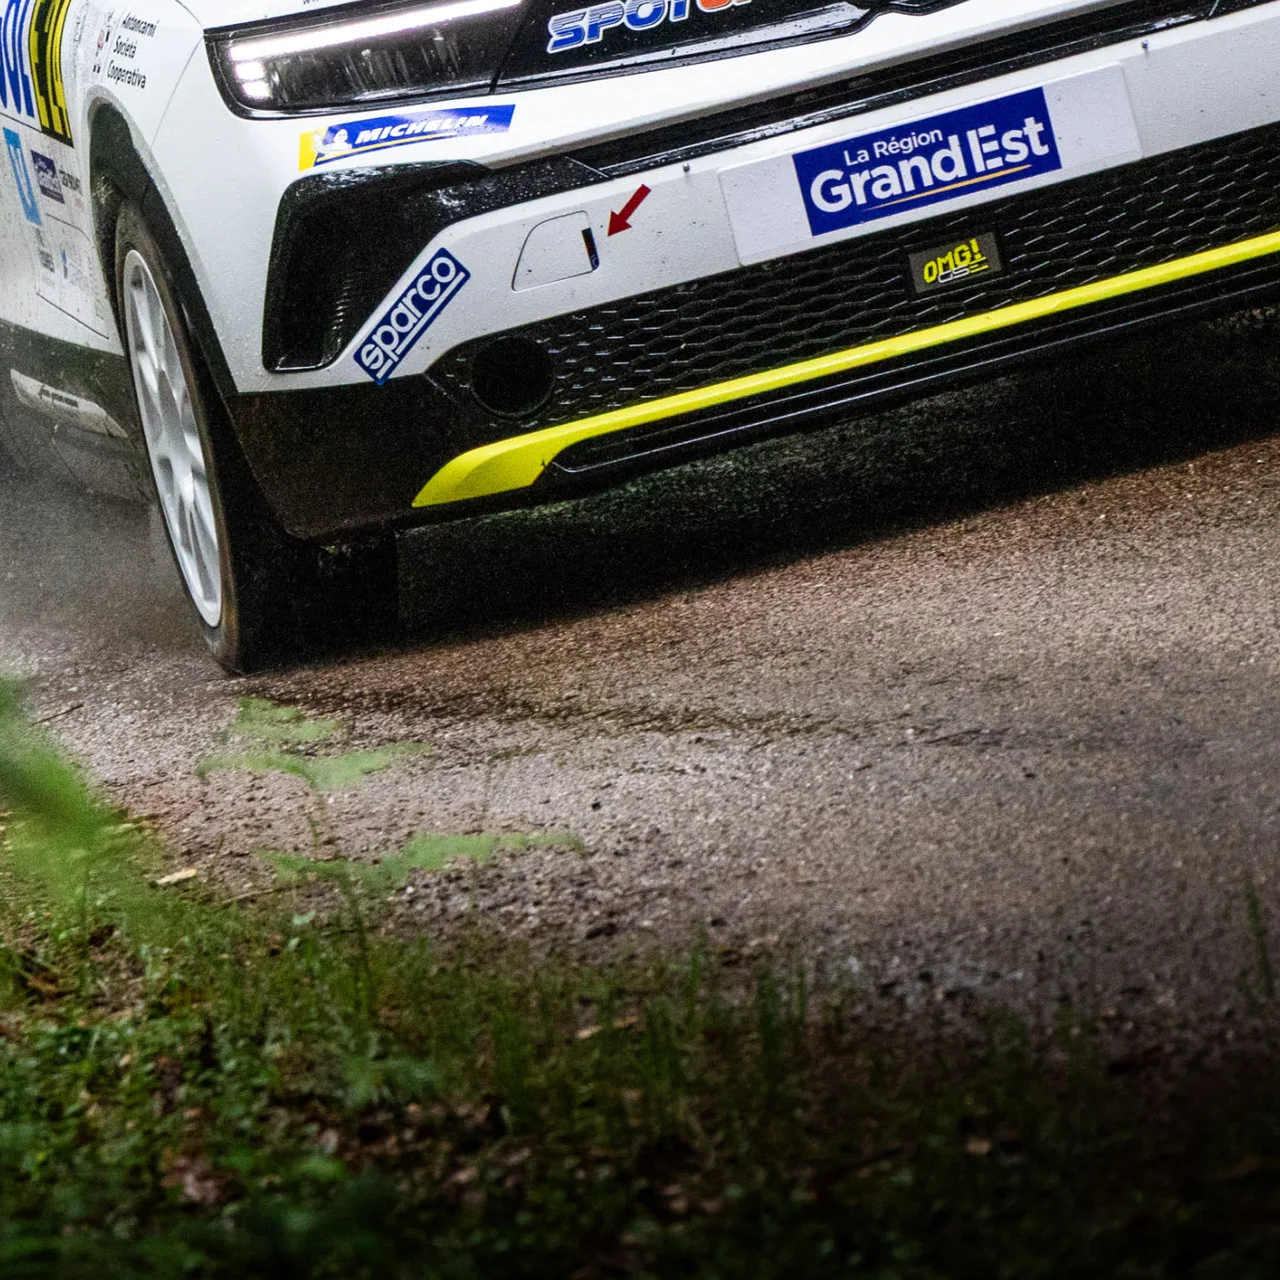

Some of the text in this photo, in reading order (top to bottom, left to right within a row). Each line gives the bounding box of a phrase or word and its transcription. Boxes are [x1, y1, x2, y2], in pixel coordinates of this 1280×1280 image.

[107, 60, 147, 89] Cooperativa
[355, 114, 489, 145] MICHELIN
[843, 128, 943, 167] La Région
[923, 238, 982, 283] OMG!
[360, 256, 457, 371] sparco
